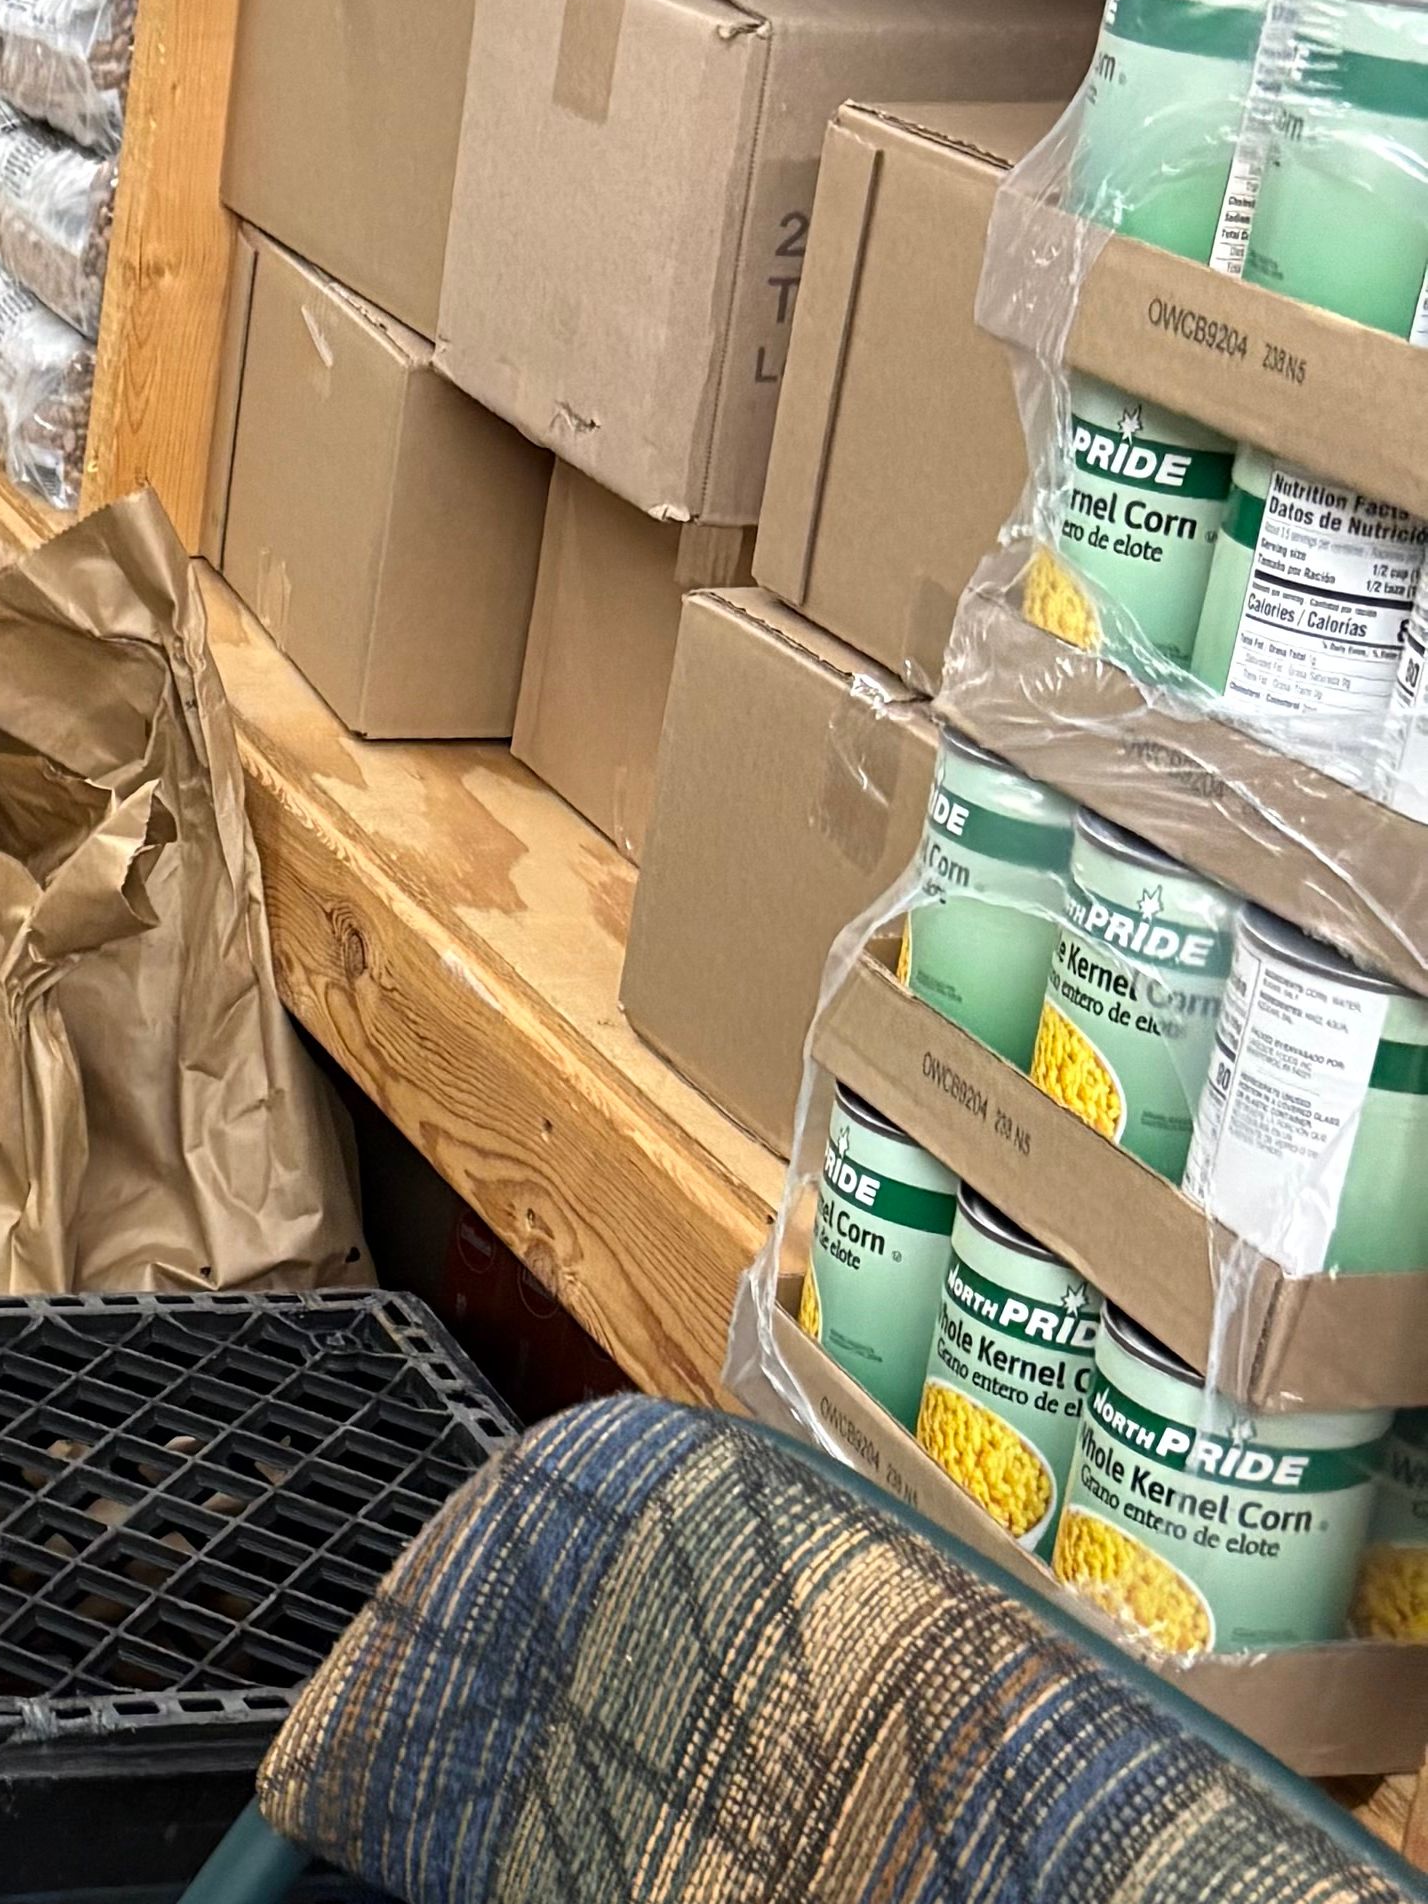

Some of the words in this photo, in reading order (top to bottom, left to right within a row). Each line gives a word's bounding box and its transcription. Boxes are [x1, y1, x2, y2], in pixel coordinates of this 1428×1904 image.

[1072, 425, 1192, 487] PRIDE
[1070, 487, 1118, 524] rnel
[1124, 499, 1197, 540] Corn
[1273, 473, 1347, 510] Nutrition
[1088, 525, 1109, 550] de
[1113, 534, 1163, 563] elote
[1269, 496, 1314, 525] Datos
[1319, 511, 1342, 532] de
[1348, 516, 1428, 545] Nutrició
[1366, 579, 1381, 593] 1/2
[1372, 563, 1388, 577] 1/2
[1247, 593, 1295, 623] Calories
[1307, 611, 1368, 638] Calorías
[1084, 903, 1215, 968] PRIDE
[1061, 982, 1104, 1016] entero
[1108, 1003, 1131, 1028] de
[830, 1239, 861, 1270] elote
[836, 1210, 885, 1255] Corn
[947, 1263, 999, 1322] NORTH
[999, 1298, 1097, 1347] PRID
[936, 1338, 970, 1380] Grano
[972, 1370, 1028, 1406] entero
[1034, 1392, 1059, 1414] de
[977, 1335, 1065, 1391] Kernel
[1092, 1387, 1156, 1448] NORTH
[1156, 1426, 1310, 1487] PRIDE
[1080, 1463, 1120, 1510] Grano
[1123, 1500, 1187, 1541] entero
[1194, 1526, 1221, 1549] de
[1225, 1534, 1281, 1558] elote
[1130, 1465, 1230, 1526] Kernel
[1237, 1501, 1313, 1534] Corn
